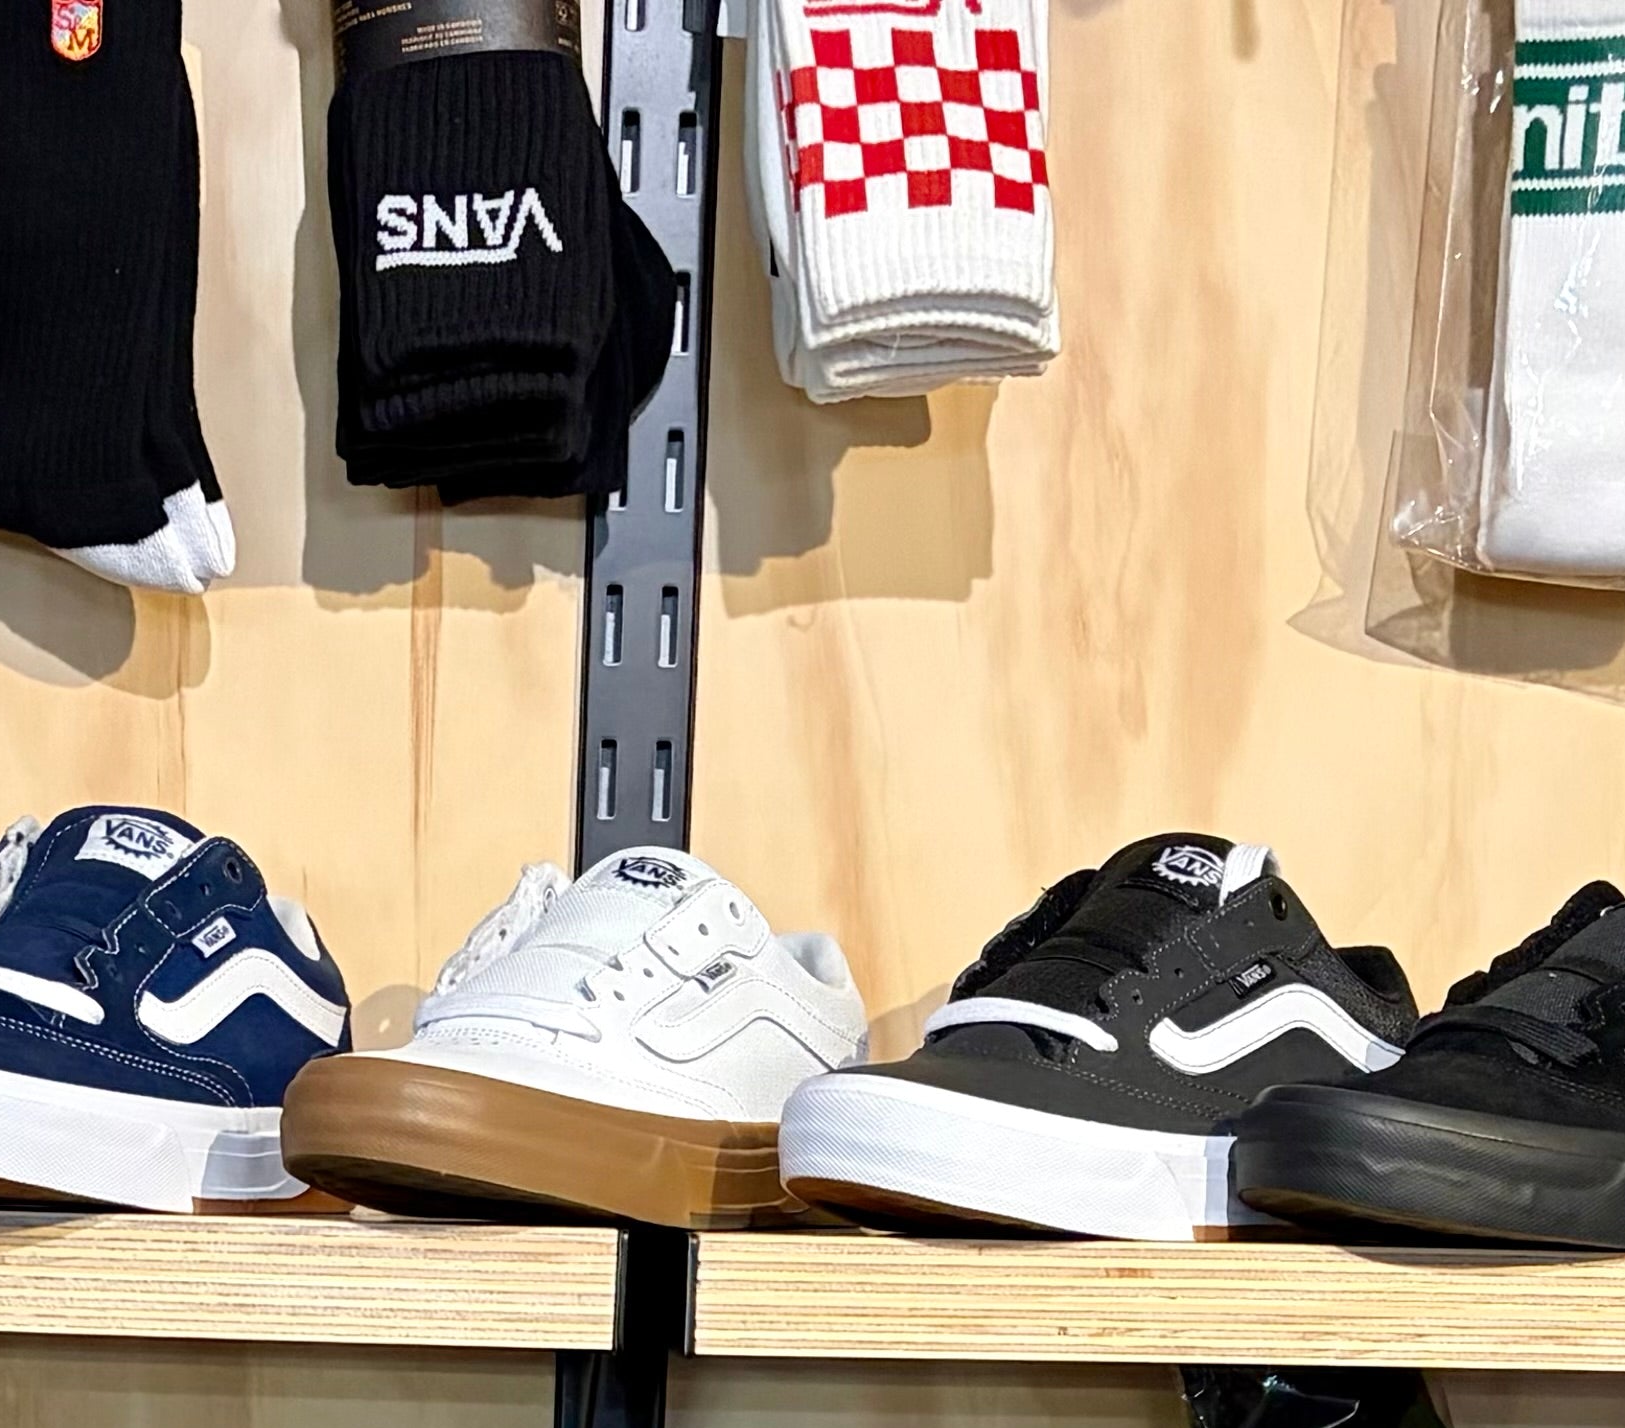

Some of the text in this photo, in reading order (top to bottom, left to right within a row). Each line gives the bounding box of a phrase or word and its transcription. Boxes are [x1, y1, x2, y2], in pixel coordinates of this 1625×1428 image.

[377, 187, 563, 271] VANS
[104, 818, 172, 855] VANS
[616, 859, 679, 886] VANS
[1160, 847, 1224, 884] VANS
[1236, 964, 1267, 988] VANS
